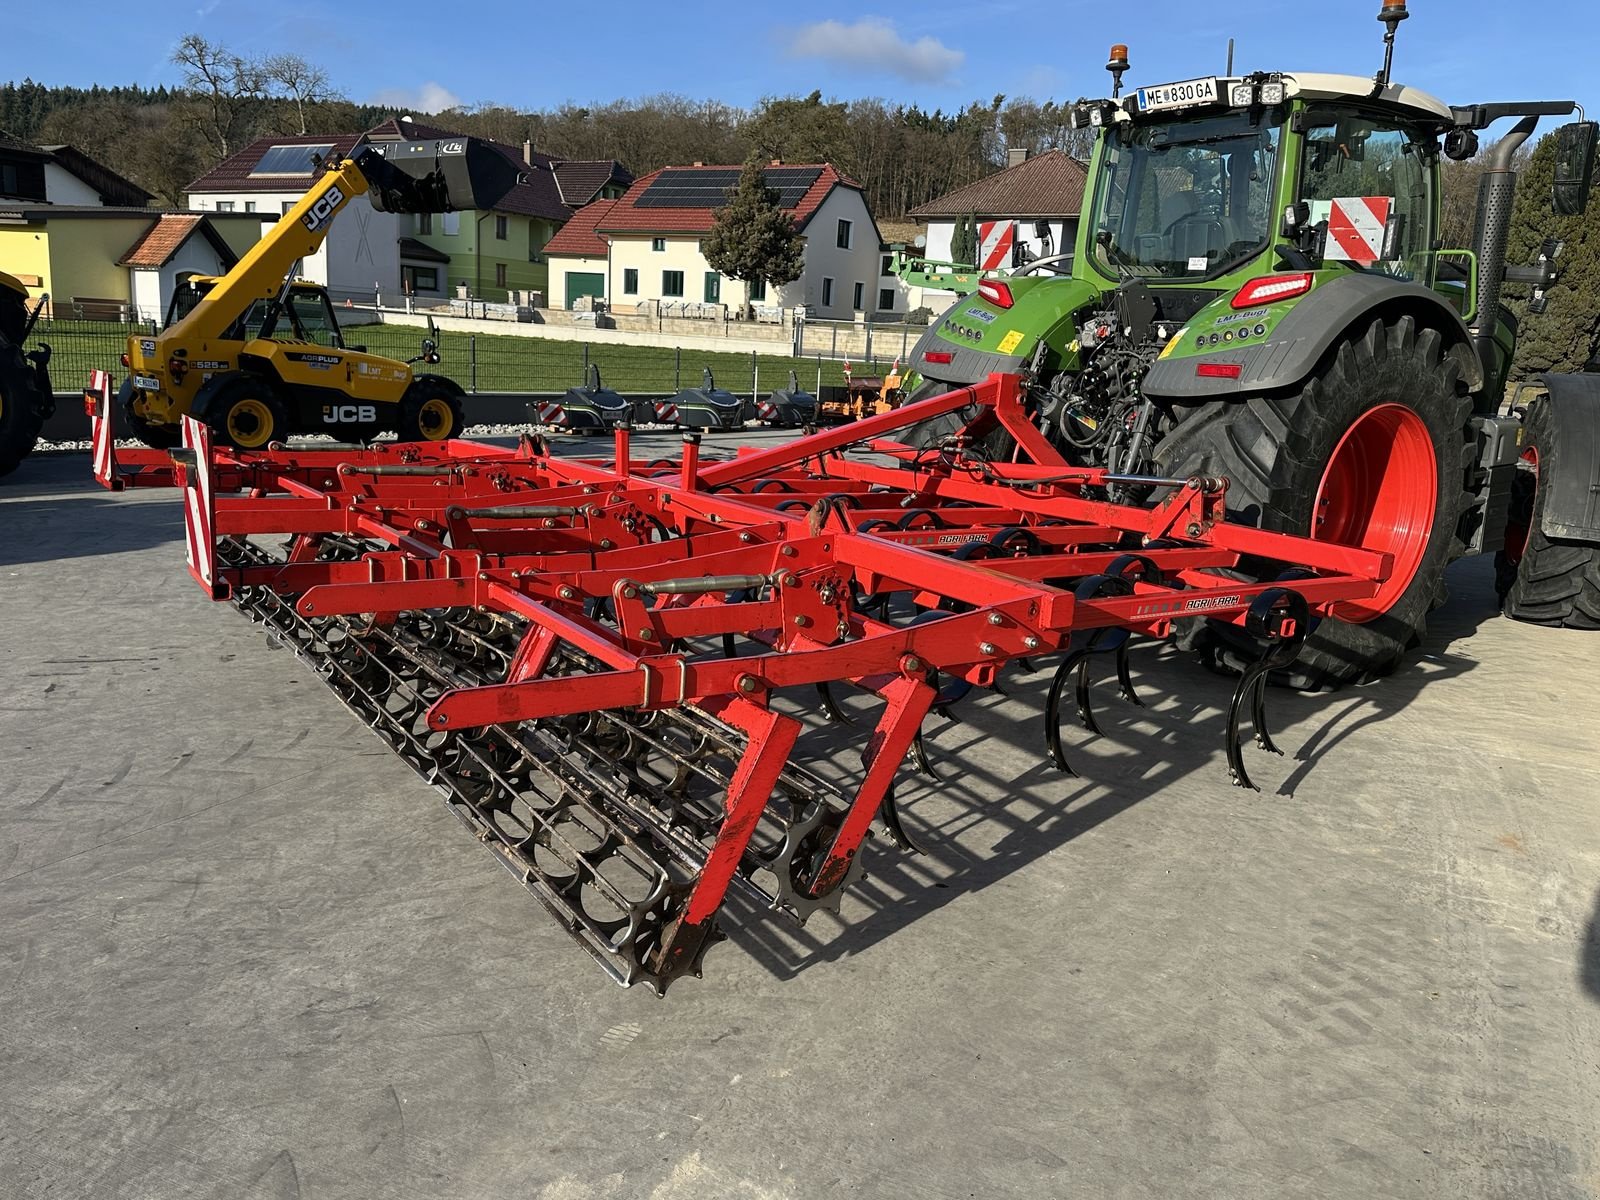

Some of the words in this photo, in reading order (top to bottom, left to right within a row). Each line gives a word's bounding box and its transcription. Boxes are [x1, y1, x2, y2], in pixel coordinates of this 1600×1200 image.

[1147, 90, 1163, 106] ME
[1170, 85, 1194, 102] 830
[1195, 82, 1213, 98] GA
[305, 186, 344, 231] JCB
[1216, 309, 1268, 324] LMT-Bugl
[141, 341, 155, 350] JCB
[322, 405, 377, 423] JCB
[1185, 598, 1211, 610] AGRI
[1211, 595, 1240, 608] FARM
